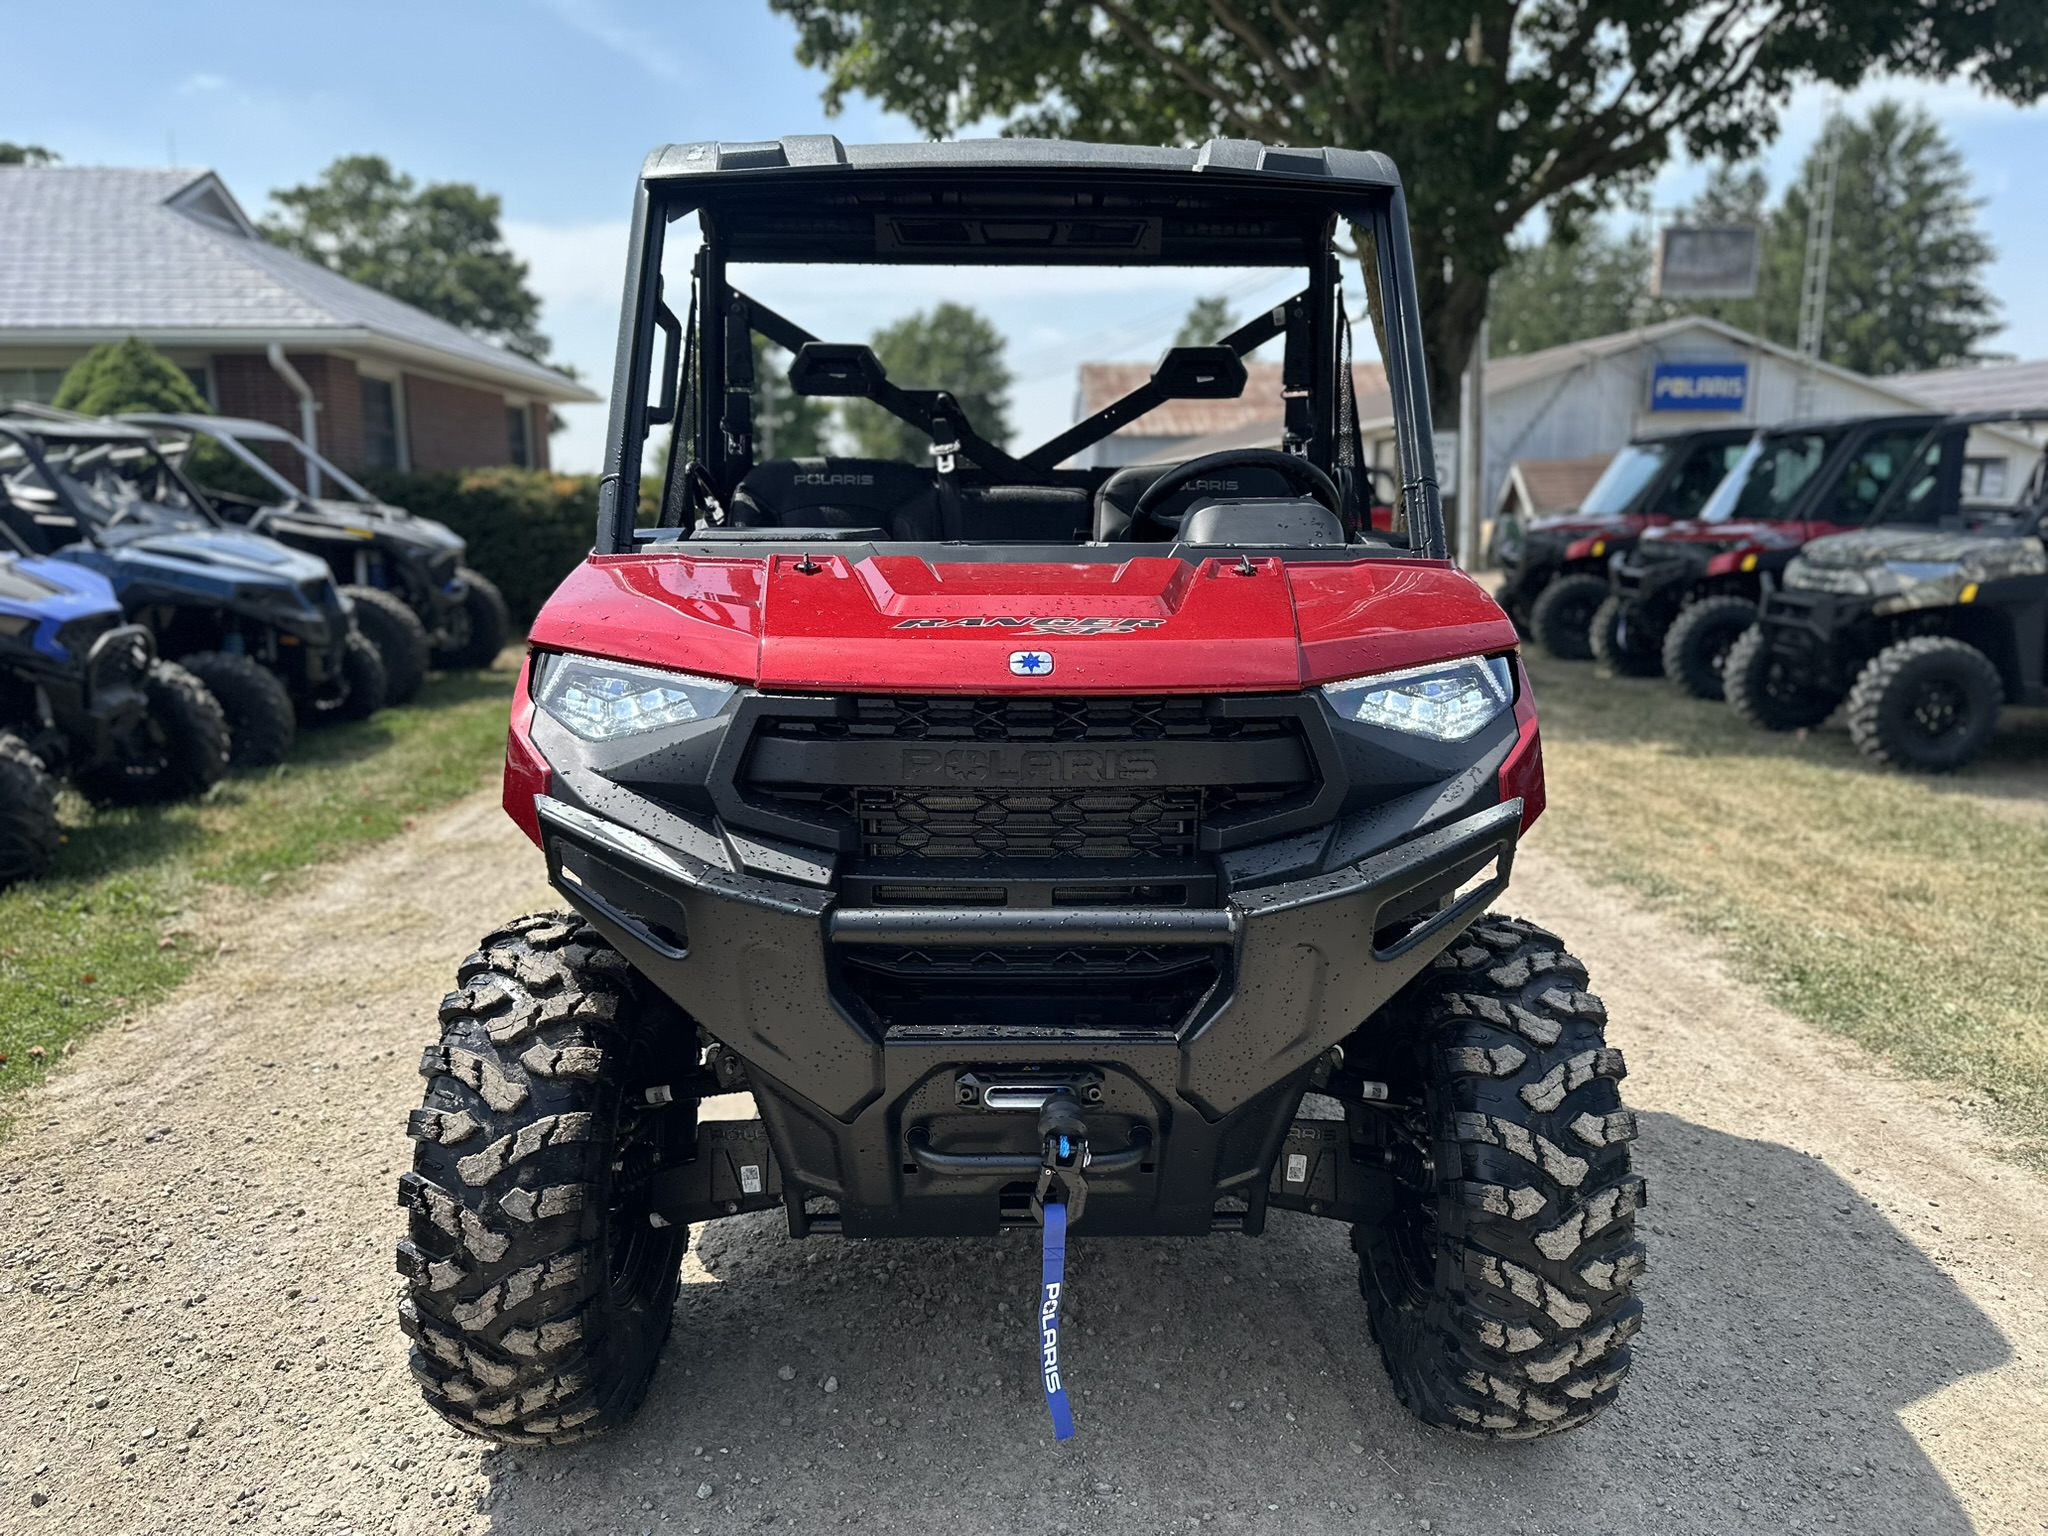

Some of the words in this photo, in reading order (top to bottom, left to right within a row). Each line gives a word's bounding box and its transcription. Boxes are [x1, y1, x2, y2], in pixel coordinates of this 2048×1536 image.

[1656, 376, 1743, 398] POLARIS
[794, 474, 874, 485] POLARIS
[1179, 480, 1239, 491] LARIS
[890, 616, 1167, 630] RANGER
[1010, 626, 1137, 636] XP
[902, 749, 1158, 781] POLARIS
[1042, 1282, 1061, 1394] POLARIS
